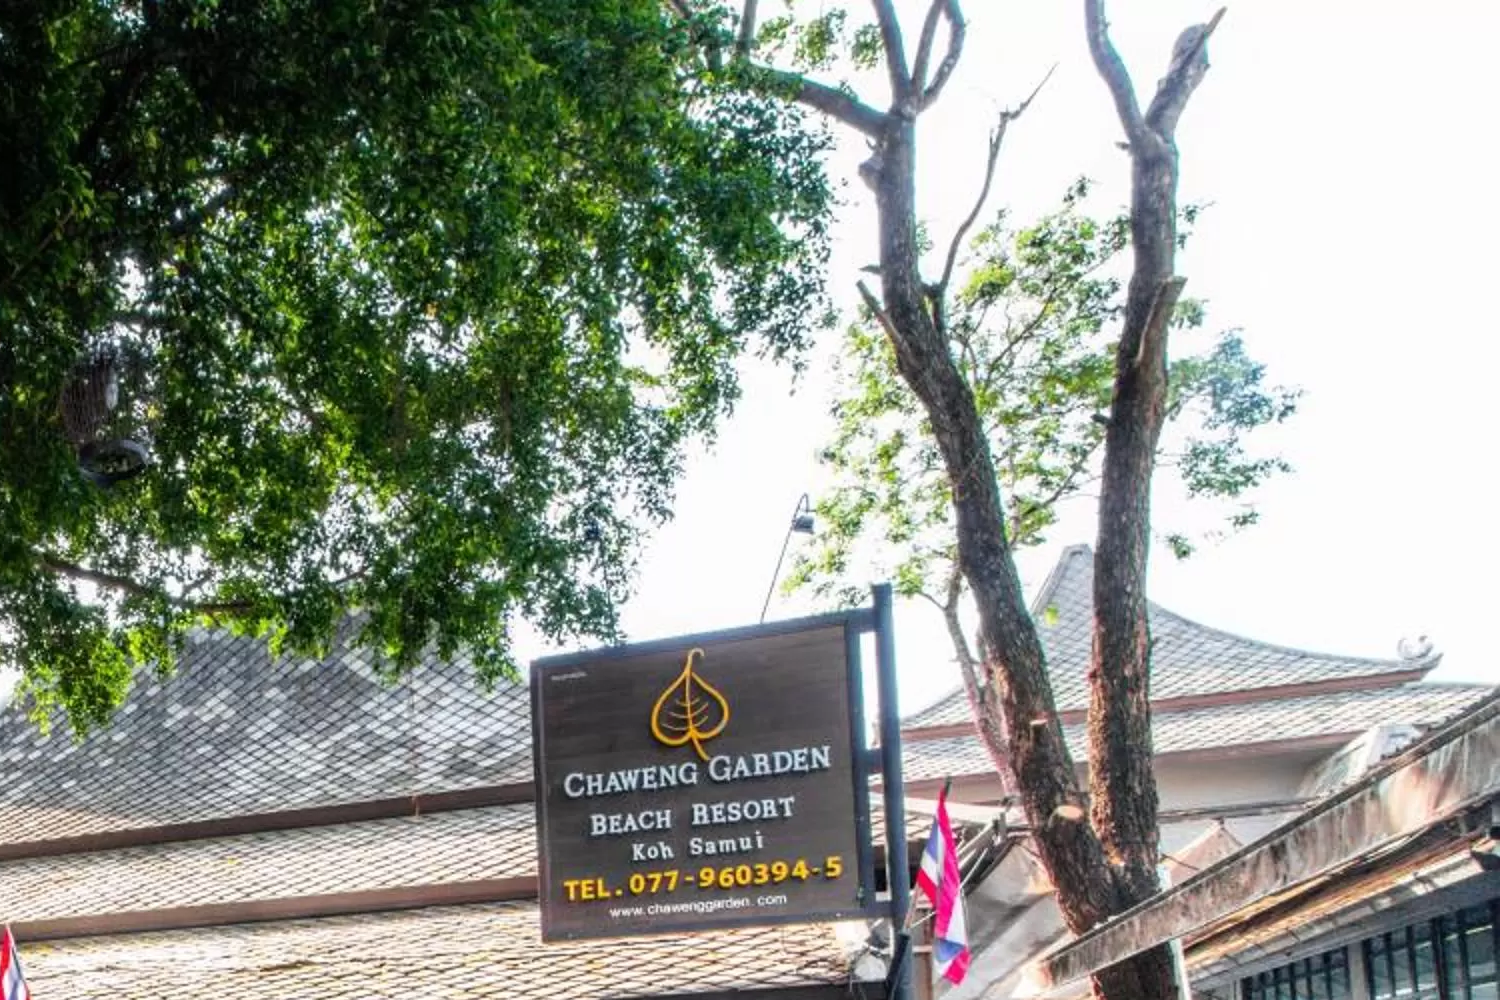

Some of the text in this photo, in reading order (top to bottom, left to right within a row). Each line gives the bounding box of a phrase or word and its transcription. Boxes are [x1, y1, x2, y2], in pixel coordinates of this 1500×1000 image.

[563, 745, 831, 798] CHAWENG GARDEN
[590, 796, 795, 836] BEACH RESORT
[632, 830, 764, 861] Koh Samui
